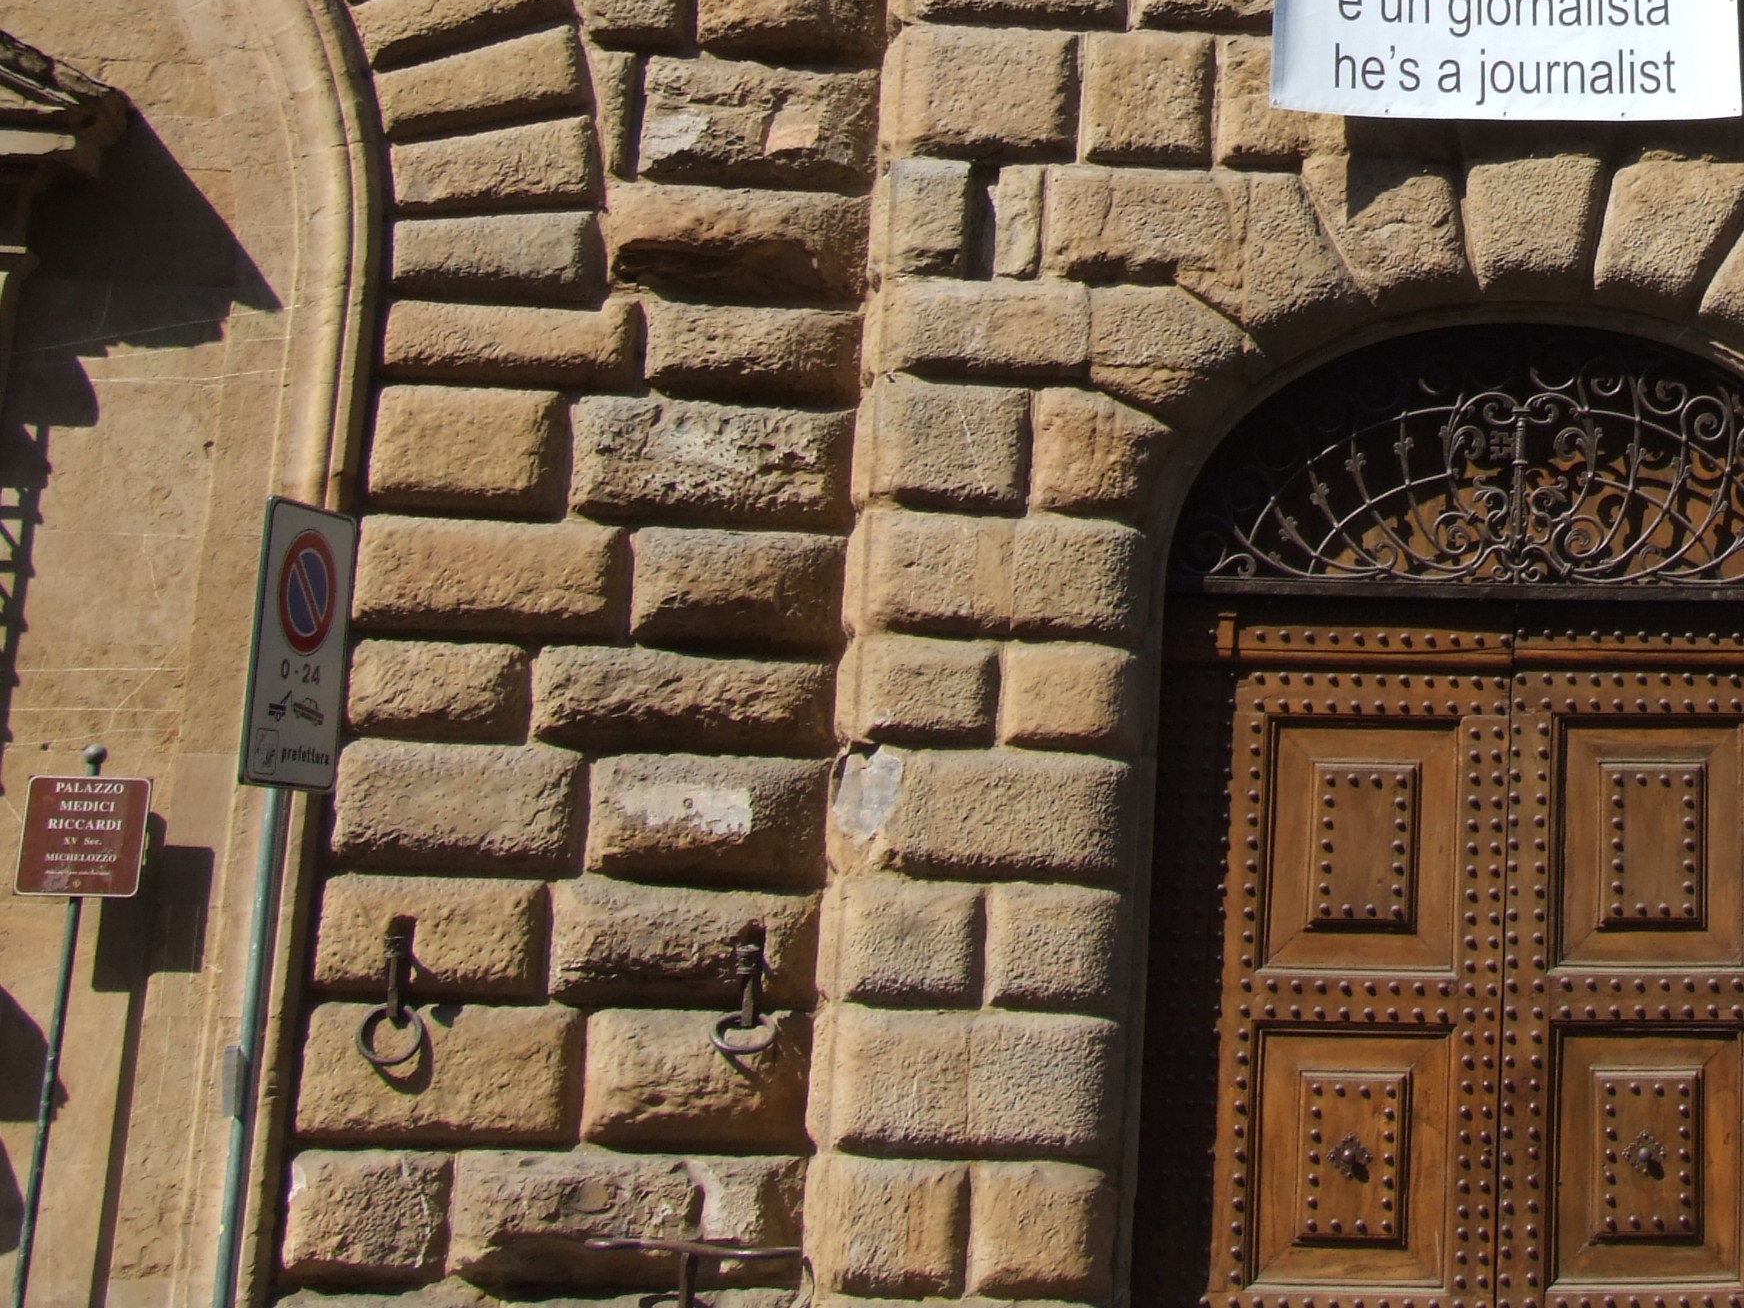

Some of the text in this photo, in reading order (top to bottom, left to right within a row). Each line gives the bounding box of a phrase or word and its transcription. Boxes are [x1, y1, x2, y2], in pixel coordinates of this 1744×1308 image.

[1333, 43, 1677, 106] he's a journalist
[301, 663, 321, 685] 24
[281, 745, 330, 766] prefettura
[55, 781, 125, 794] PALAZZO
[59, 799, 116, 813] MEDICI
[47, 817, 123, 831] RICCARDI
[63, 836, 79, 845] XV
[44, 852, 118, 863] MICHELOZZO
